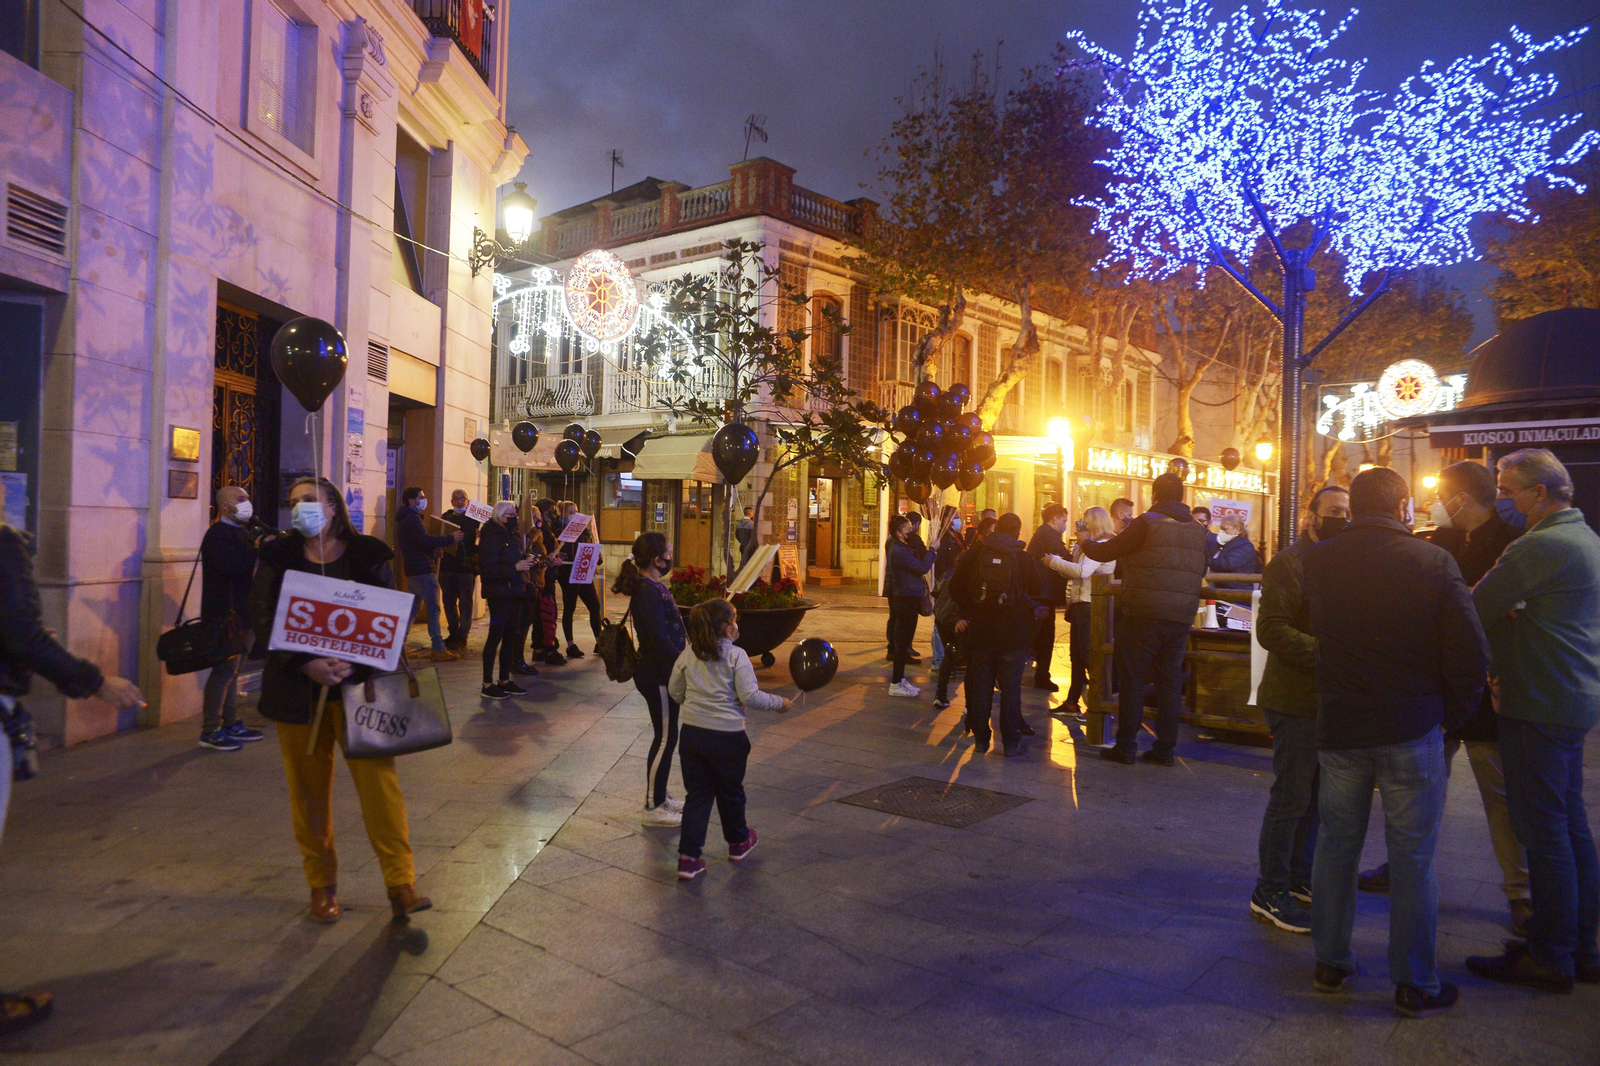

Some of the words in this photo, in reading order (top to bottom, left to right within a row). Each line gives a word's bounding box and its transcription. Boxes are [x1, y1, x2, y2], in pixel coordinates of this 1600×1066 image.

[1463, 431, 1515, 446] KIOSCO
[287, 600, 396, 645] S.O.S
[284, 631, 387, 660] HOSTELERIA
[354, 705, 410, 738] GUESS
